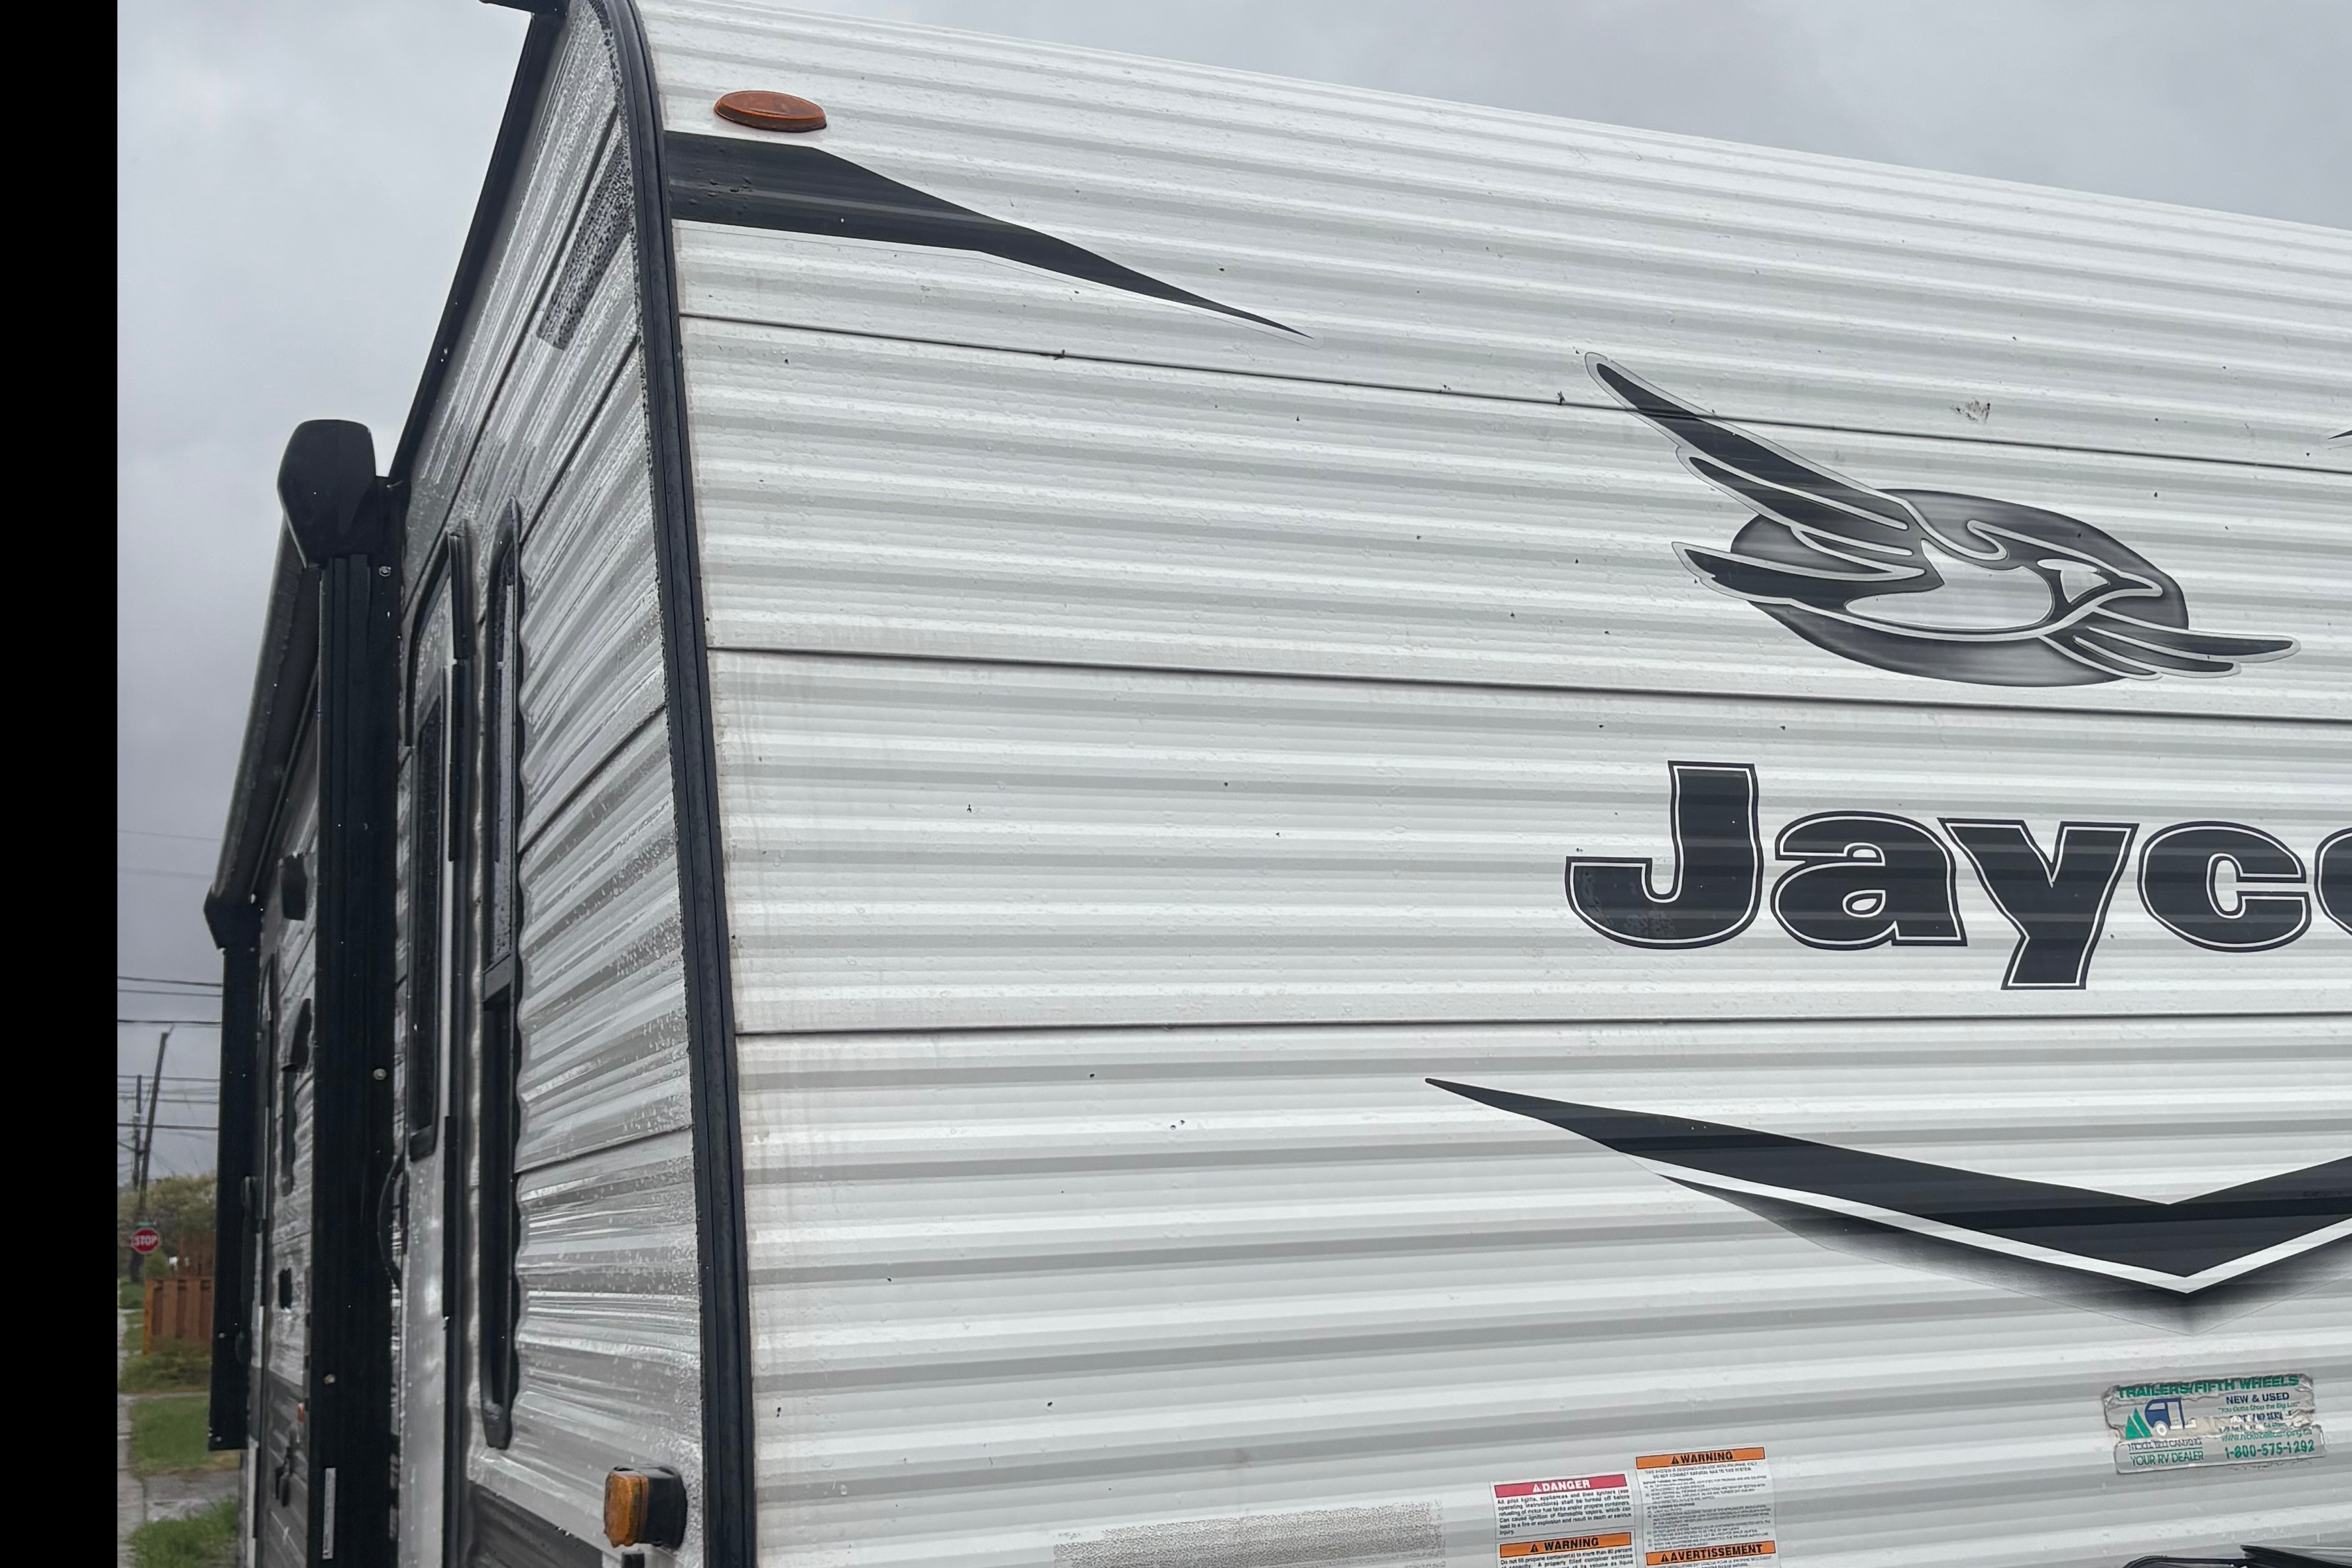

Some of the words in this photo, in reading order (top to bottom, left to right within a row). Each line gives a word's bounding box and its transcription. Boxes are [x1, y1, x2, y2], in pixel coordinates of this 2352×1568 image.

[1566, 760, 2352, 991] Jayc
[134, 1235, 157, 1246] STOP
[2239, 1374, 2299, 1390] WHEELS
[2226, 1395, 2248, 1404] NEW
[2262, 1392, 2290, 1402] USED
[1680, 1451, 1733, 1464] WARNING
[2130, 1454, 2155, 1466] YOUR
[2158, 1453, 2170, 1464] RV
[2171, 1451, 2204, 1463] DEALER
[1541, 1480, 1591, 1492] DANGER
[1544, 1537, 1599, 1551] WARNING
[1671, 1544, 1762, 1563] AVERTISSEMENT
